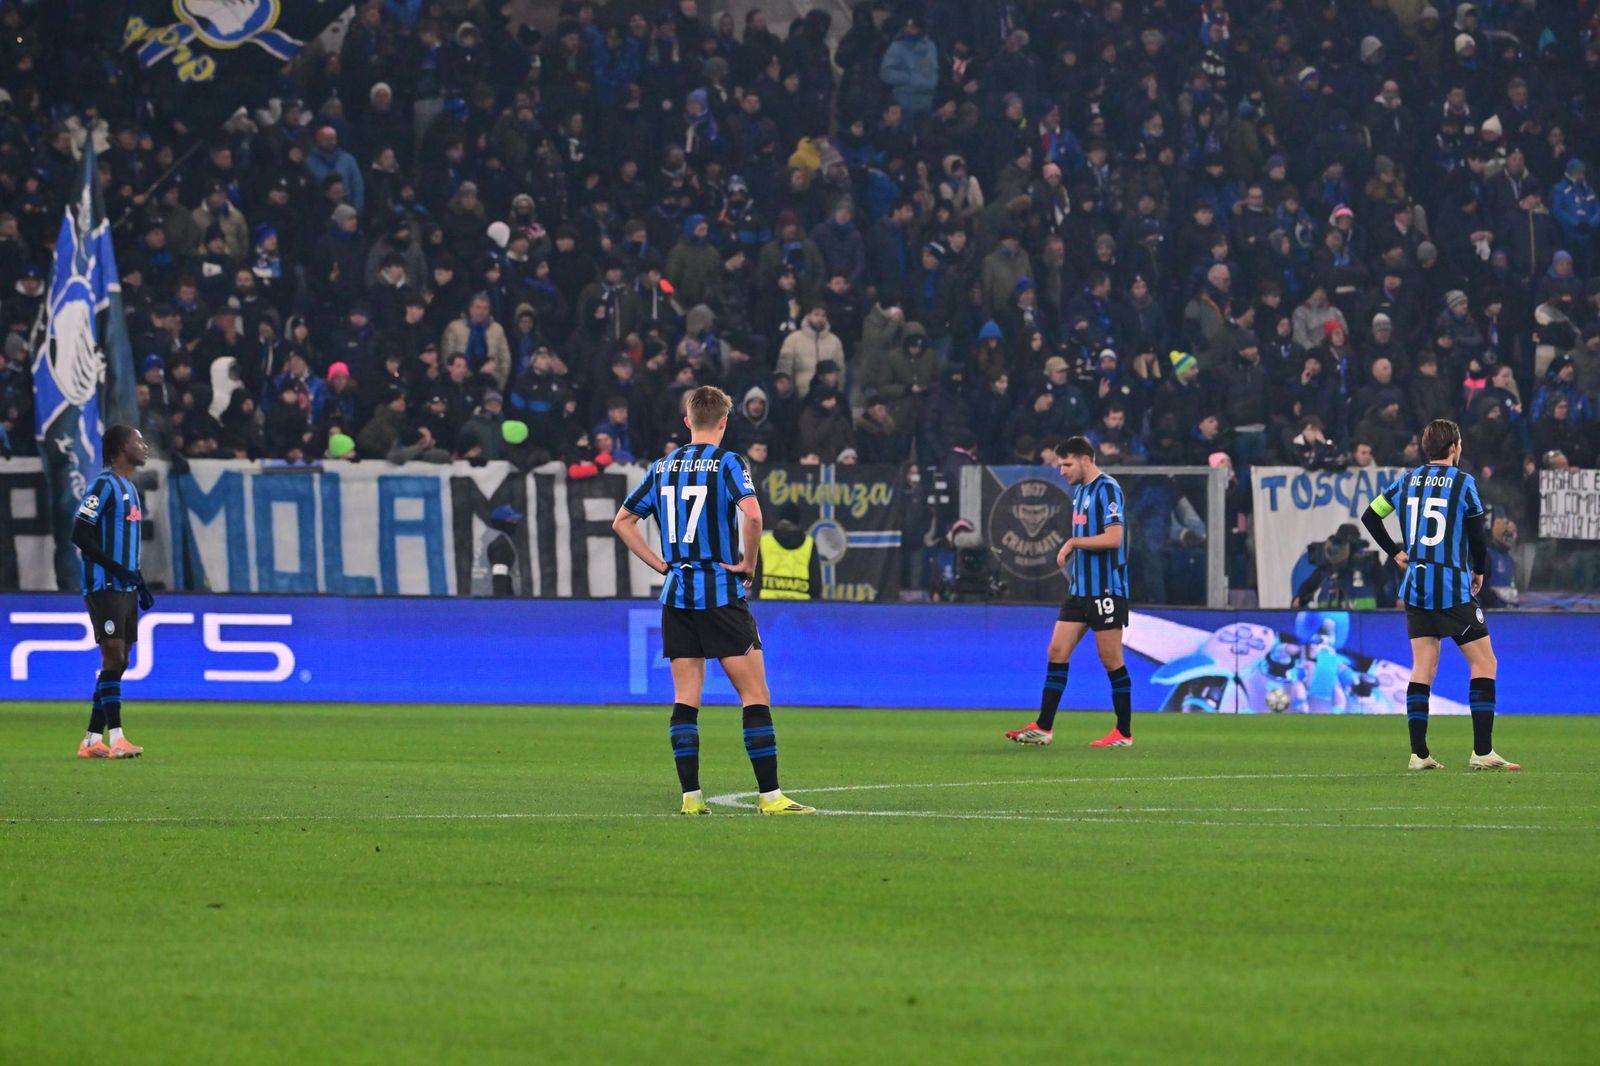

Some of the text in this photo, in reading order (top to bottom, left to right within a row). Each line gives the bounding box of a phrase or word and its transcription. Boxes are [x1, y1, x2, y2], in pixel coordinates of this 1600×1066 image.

[656, 459, 720, 473] DE KETELAERE
[1411, 475, 1452, 488] DE ROON
[661, 485, 707, 543] 17
[762, 470, 893, 518] Brianza
[1261, 470, 1400, 518] TOSCAN
[168, 469, 449, 593] MOLA
[1407, 497, 1448, 546] 15
[762, 576, 809, 592] TEWARD
[1095, 597, 1115, 615] 19
[10, 612, 296, 682] PS5
